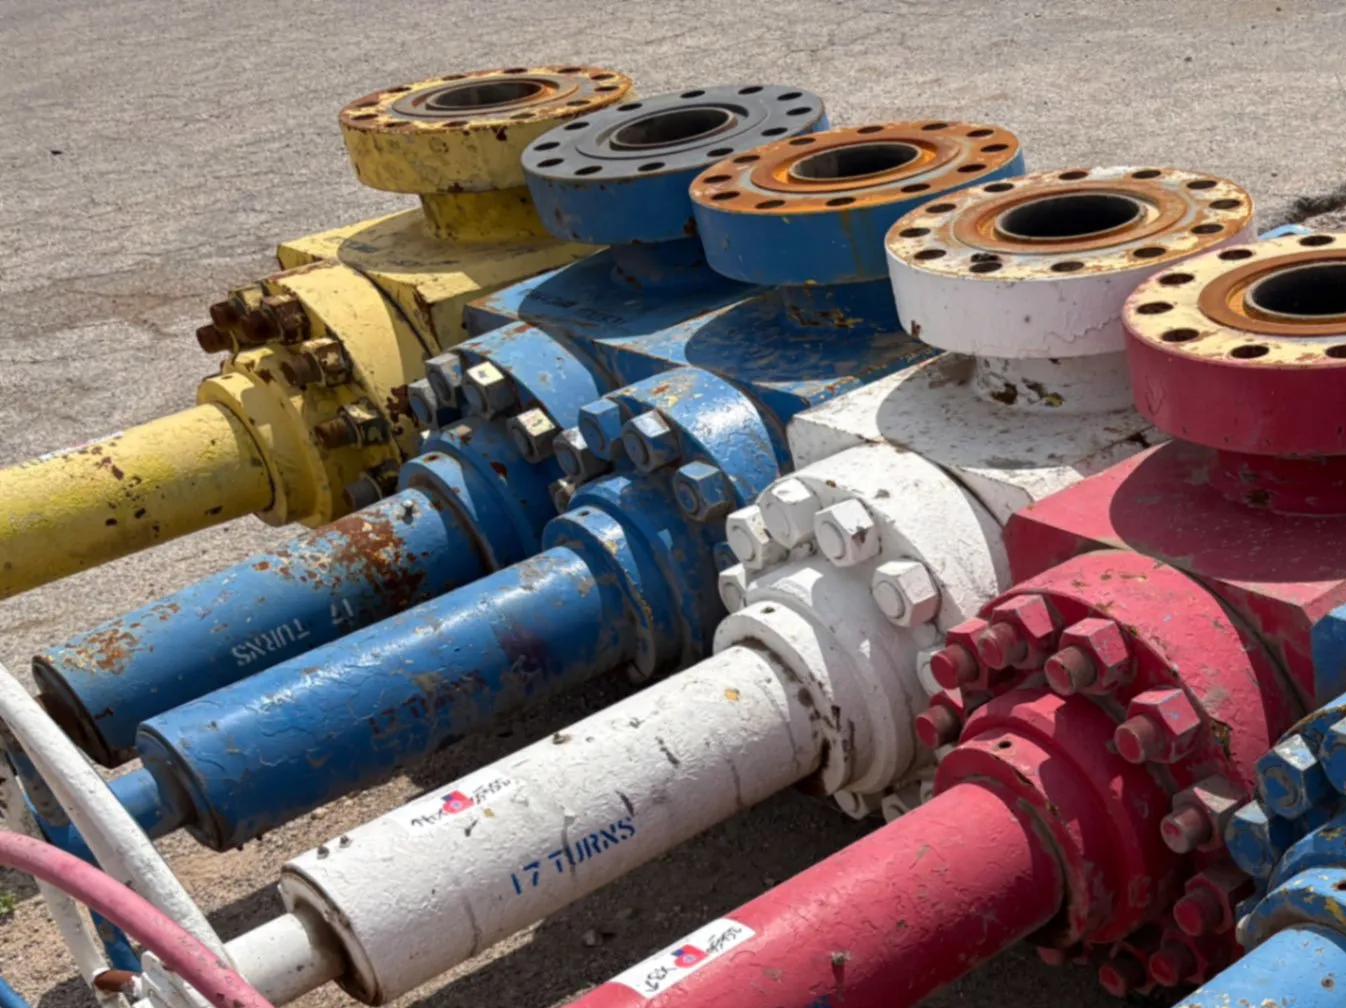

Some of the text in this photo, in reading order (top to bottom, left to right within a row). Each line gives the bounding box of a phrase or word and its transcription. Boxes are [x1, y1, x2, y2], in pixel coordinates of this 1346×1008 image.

[231, 598, 355, 666] 17 TURNS
[511, 816, 636, 895] 17 TURNS
